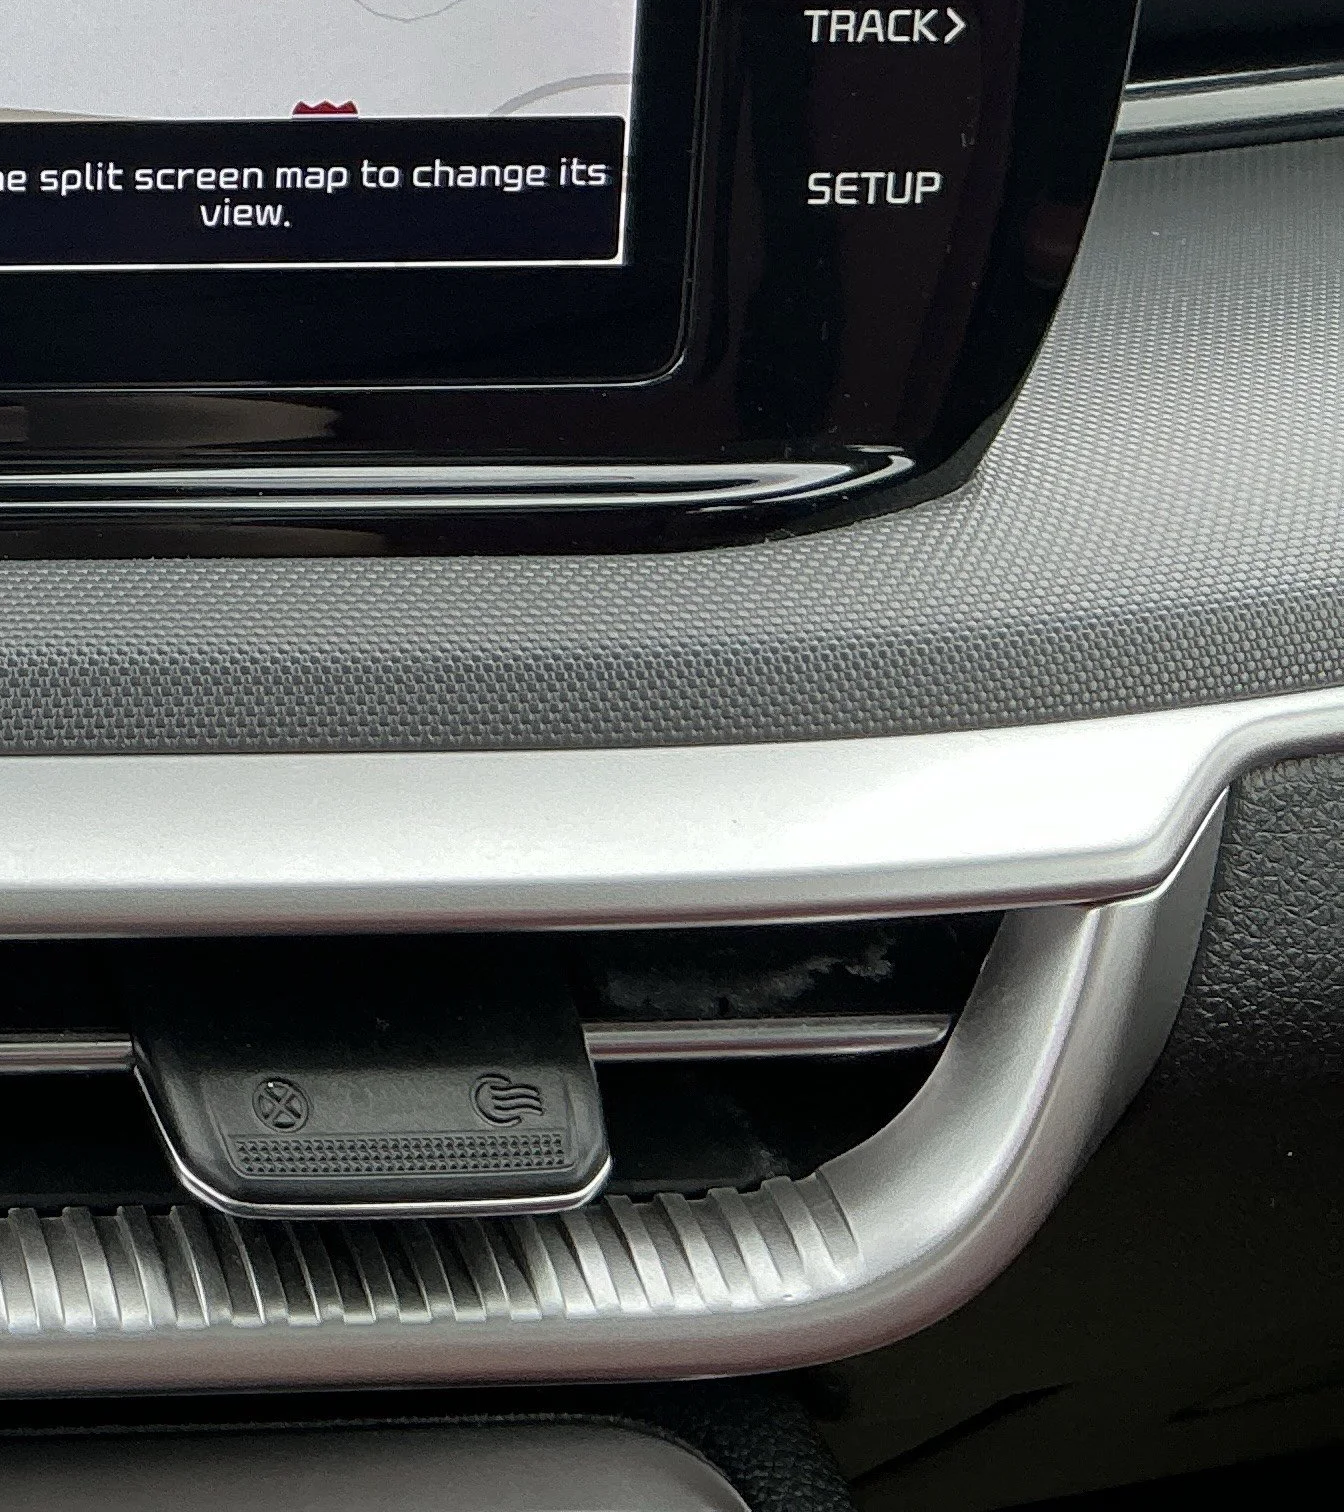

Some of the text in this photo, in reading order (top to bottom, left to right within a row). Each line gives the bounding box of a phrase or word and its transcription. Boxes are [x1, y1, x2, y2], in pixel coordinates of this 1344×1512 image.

[804, 9, 938, 42] TRACK
[41, 162, 123, 196] split
[135, 168, 263, 190] screen
[276, 167, 348, 193] map
[361, 160, 400, 188] to
[413, 159, 546, 191] change
[560, 158, 607, 186] its
[808, 172, 941, 204] SETUP
[201, 198, 290, 227] view.
